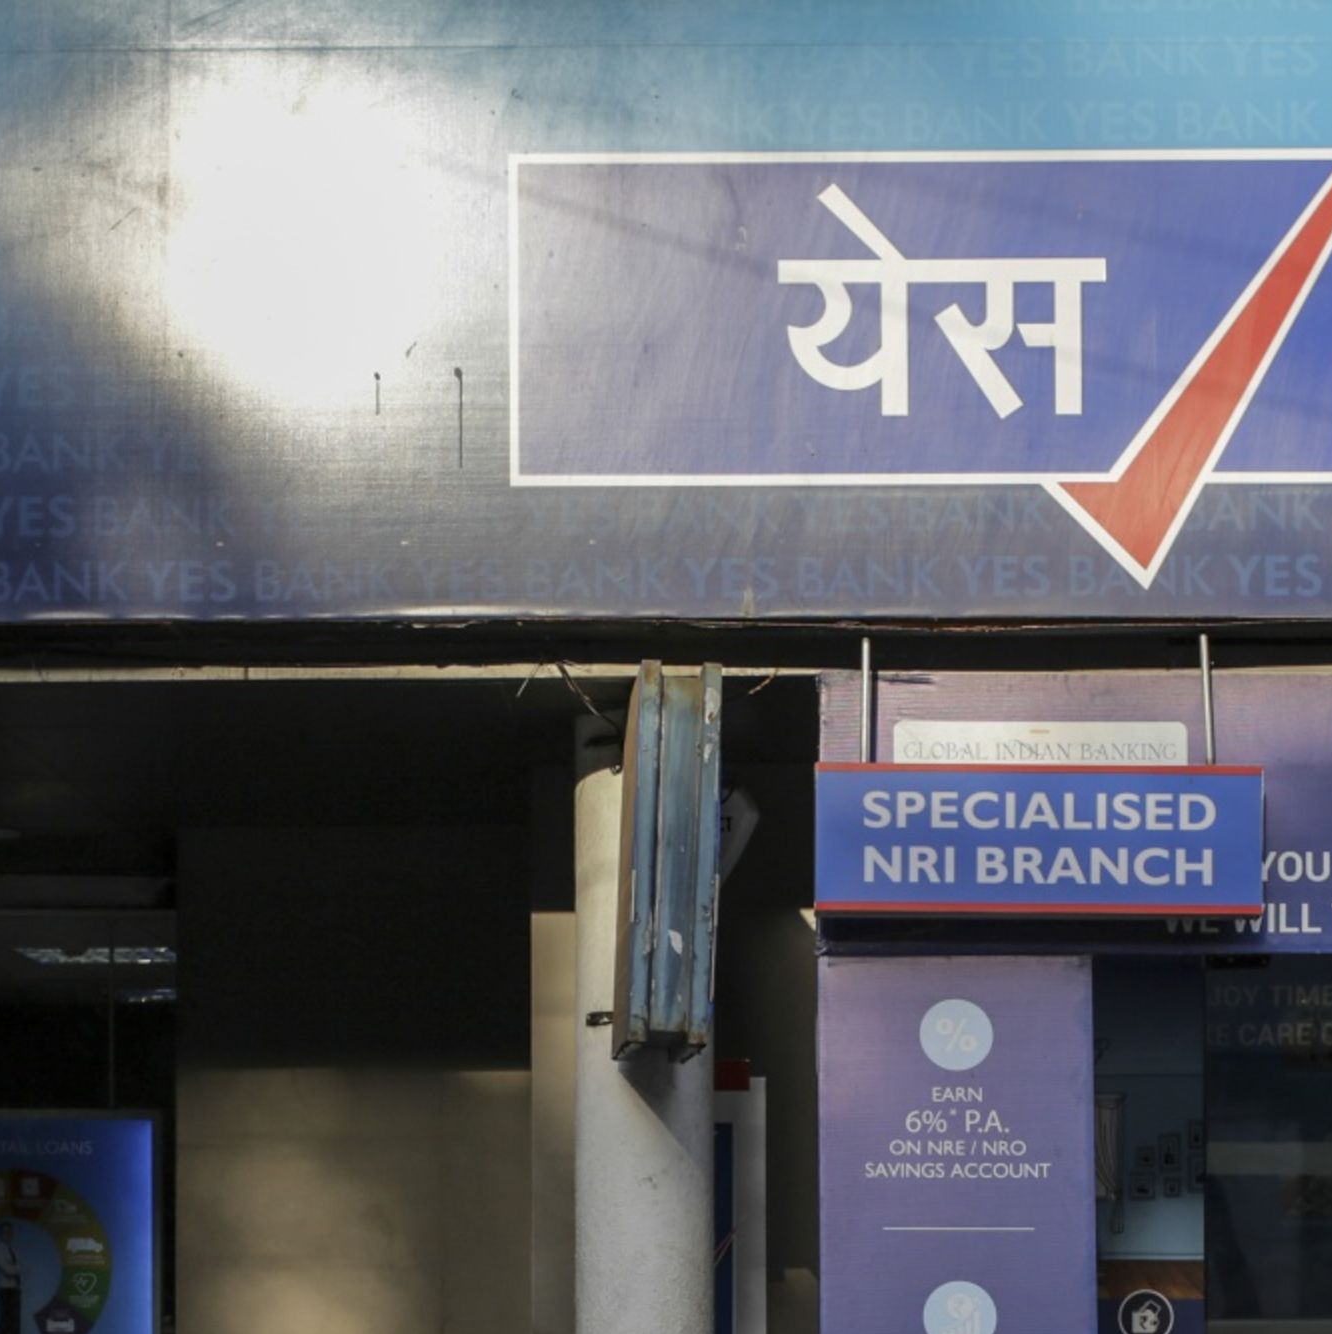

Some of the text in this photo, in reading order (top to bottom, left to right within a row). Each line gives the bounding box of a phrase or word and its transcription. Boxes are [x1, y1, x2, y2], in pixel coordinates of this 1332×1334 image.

[777, 183, 1107, 420] येस
[1227, 555, 1321, 597] YES
[903, 741, 1178, 761] GLOBAL INDIAN BANKING
[862, 790, 1216, 831] SPECIALISED
[863, 846, 1213, 886] NRI BRANCH
[1261, 851, 1330, 882] YOU
[931, 1087, 983, 1103] EARN
[965, 1110, 1010, 1133] P.A.
[35, 1140, 94, 1156] LOANS
[889, 1140, 922, 1157] ON
[927, 1140, 965, 1157] NRE
[983, 1140, 1027, 1157] NRO
[865, 1162, 1052, 1179] SAVINGS ACCOUNT
